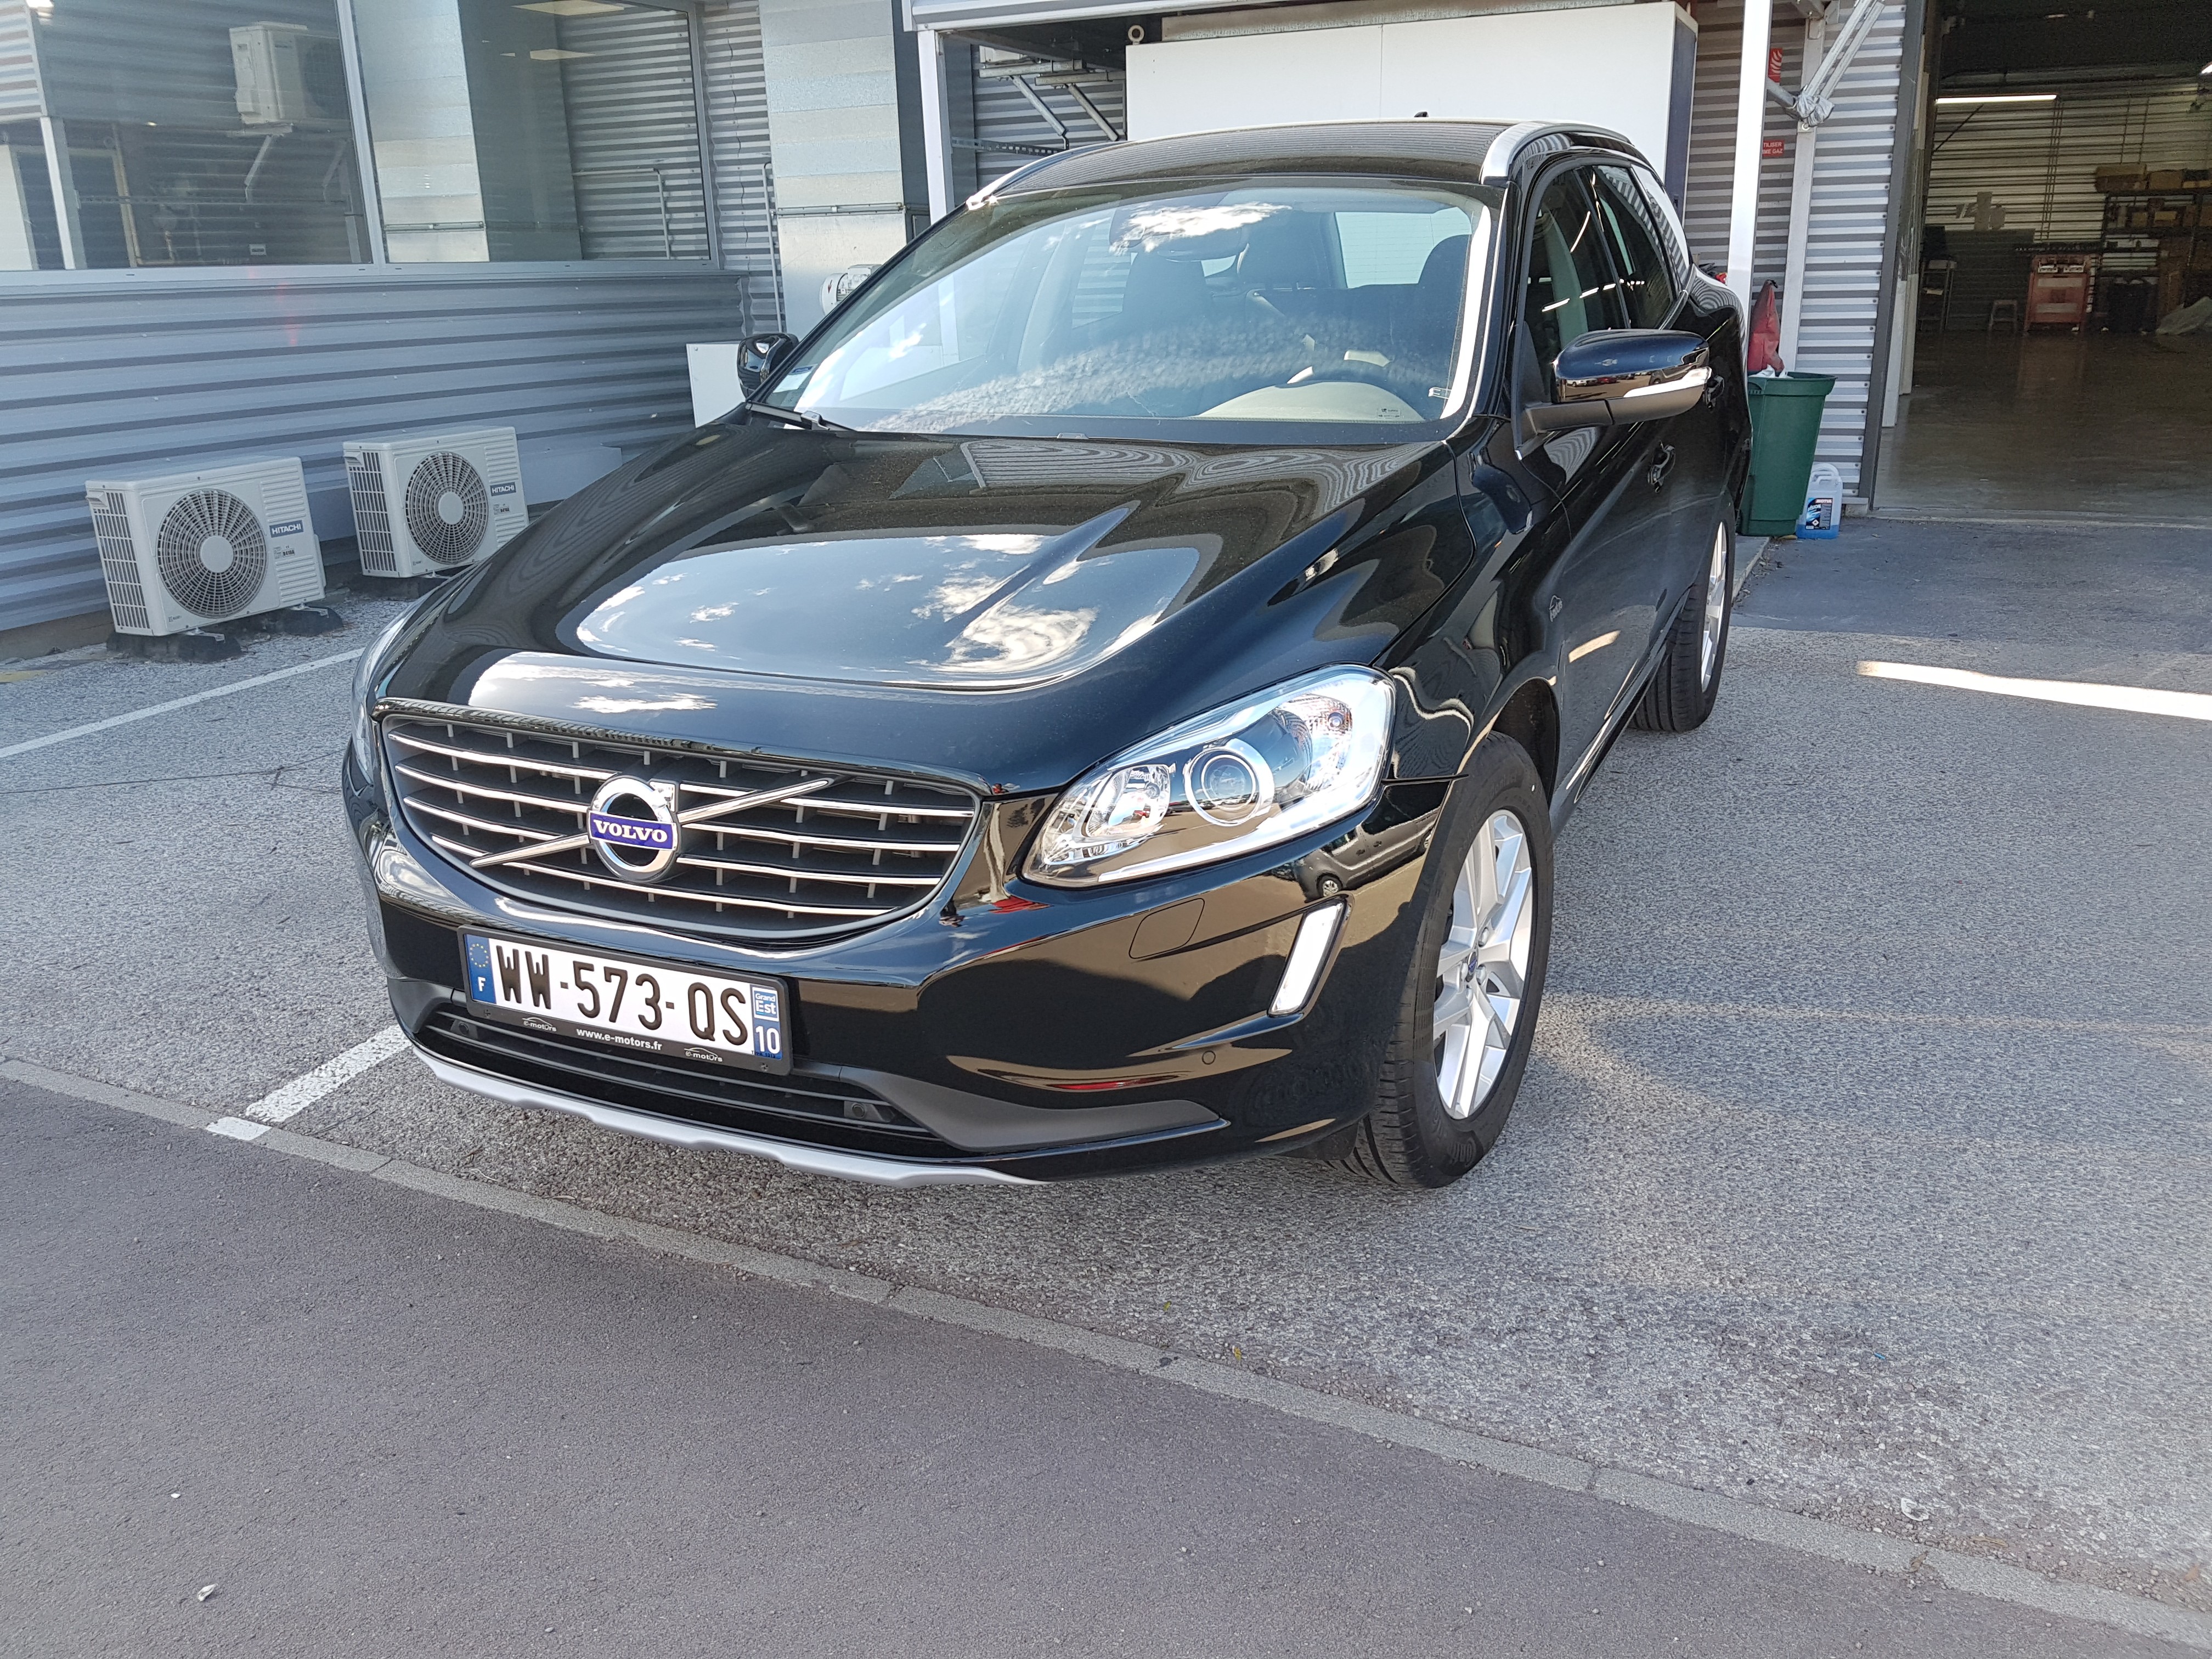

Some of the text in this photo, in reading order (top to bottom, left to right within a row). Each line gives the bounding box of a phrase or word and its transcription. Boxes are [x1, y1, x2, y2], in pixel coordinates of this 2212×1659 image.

[492, 485, 515, 494] HITACHI
[272, 523, 301, 534] HITACHI
[593, 819, 668, 843] VOLVO
[478, 977, 486, 992] F
[496, 945, 748, 1046] WW-573-QS
[755, 993, 776, 1002] Grand
[755, 1000, 776, 1014] Est
[576, 1028, 662, 1051] www.e-motors.fr
[755, 1025, 780, 1054] 10
